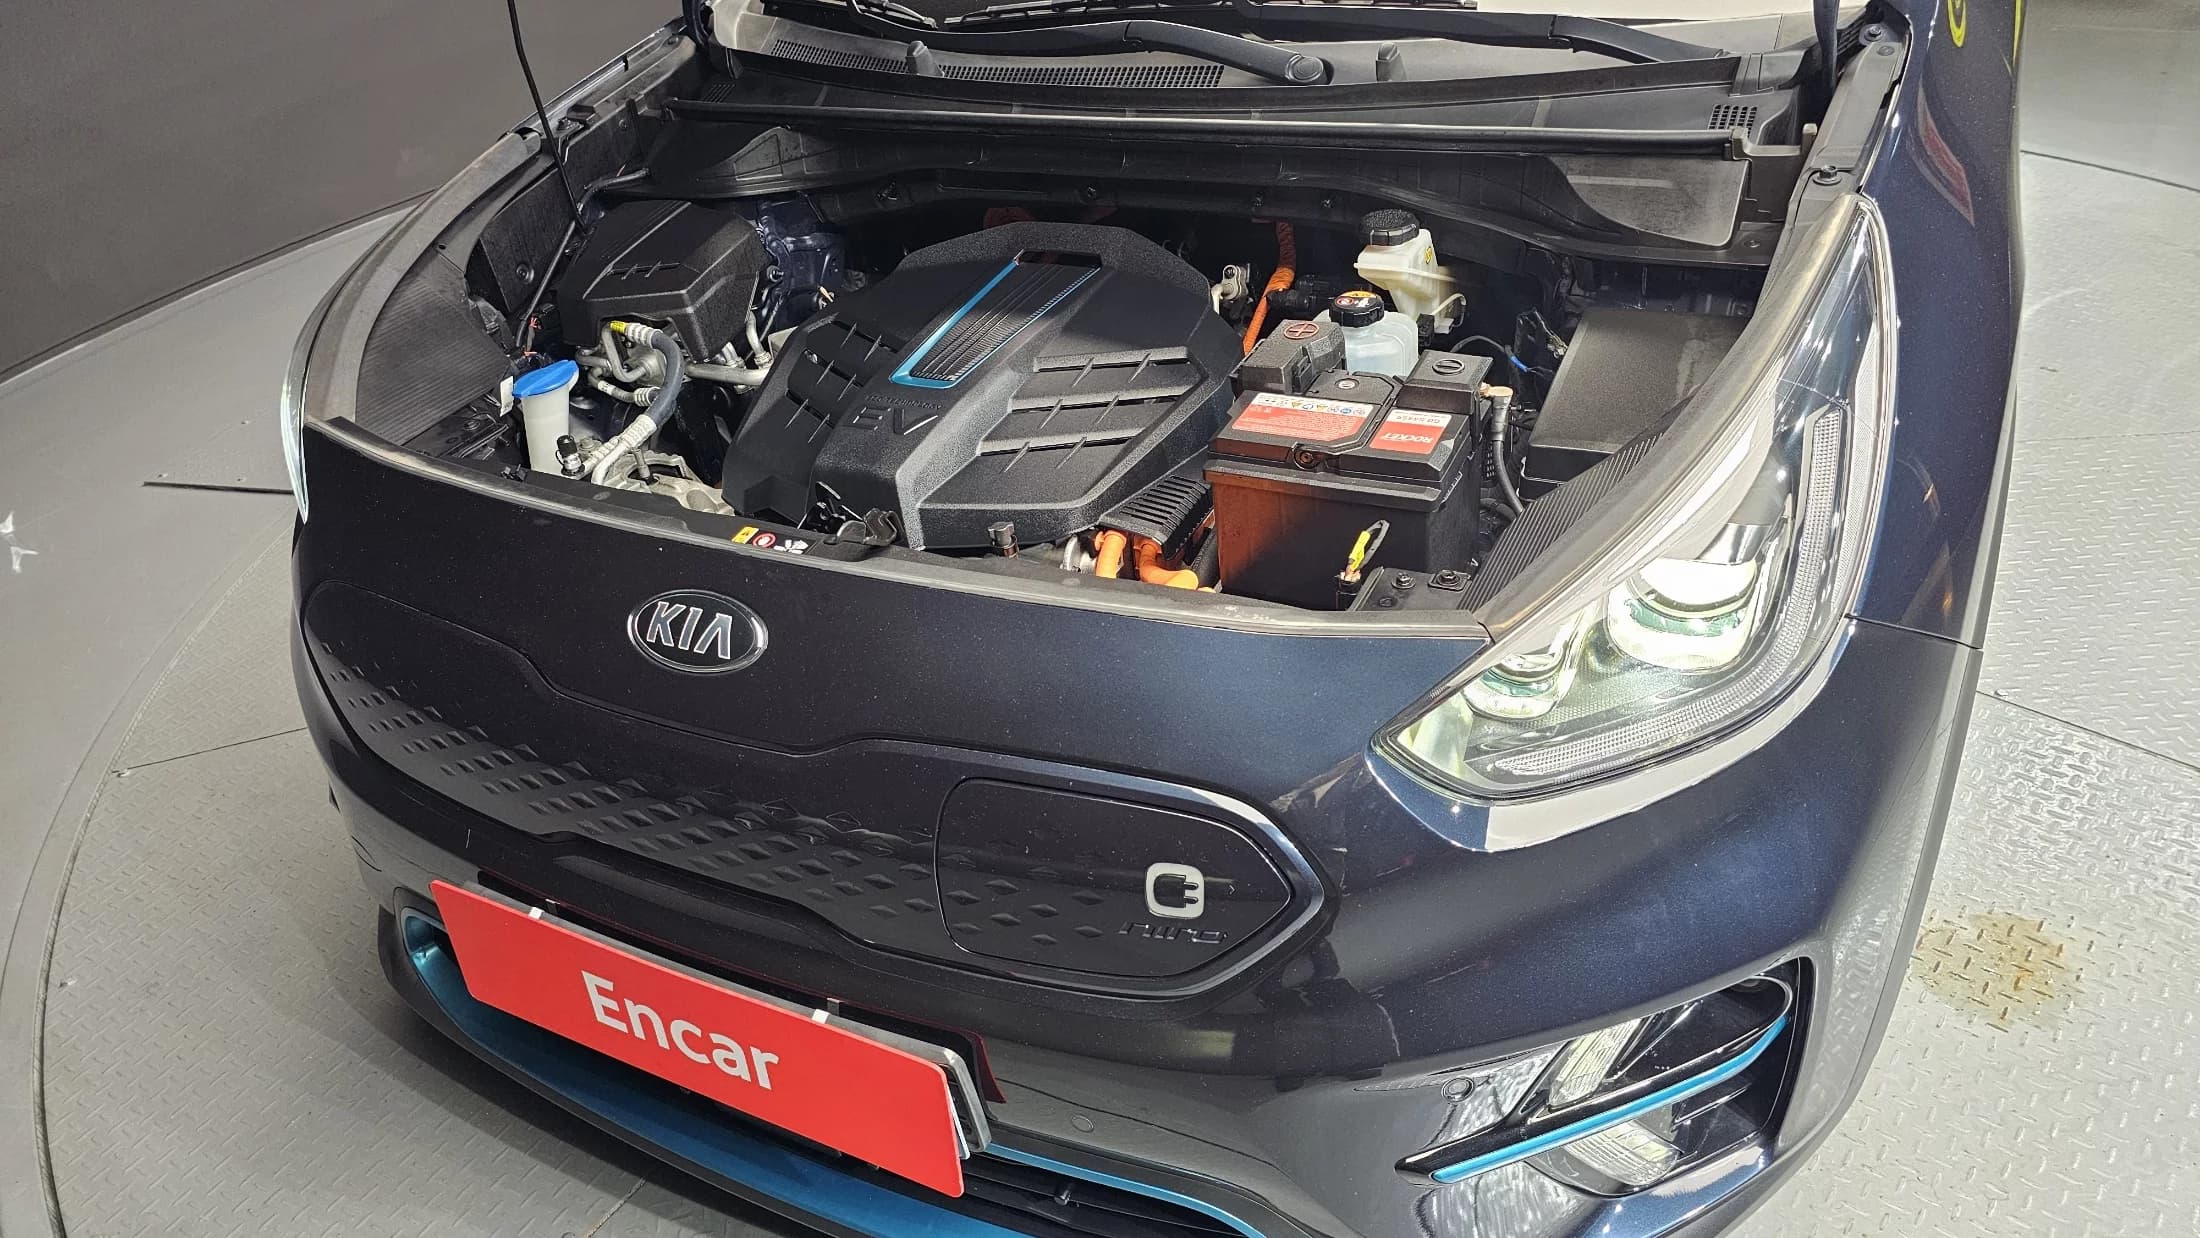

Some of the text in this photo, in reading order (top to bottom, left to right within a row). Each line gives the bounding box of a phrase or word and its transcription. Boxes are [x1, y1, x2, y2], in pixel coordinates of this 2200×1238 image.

[844, 405, 939, 435] EV
[1381, 432, 1433, 444] ROCKET
[646, 601, 733, 660] KIA
[580, 970, 780, 1091] Encar
